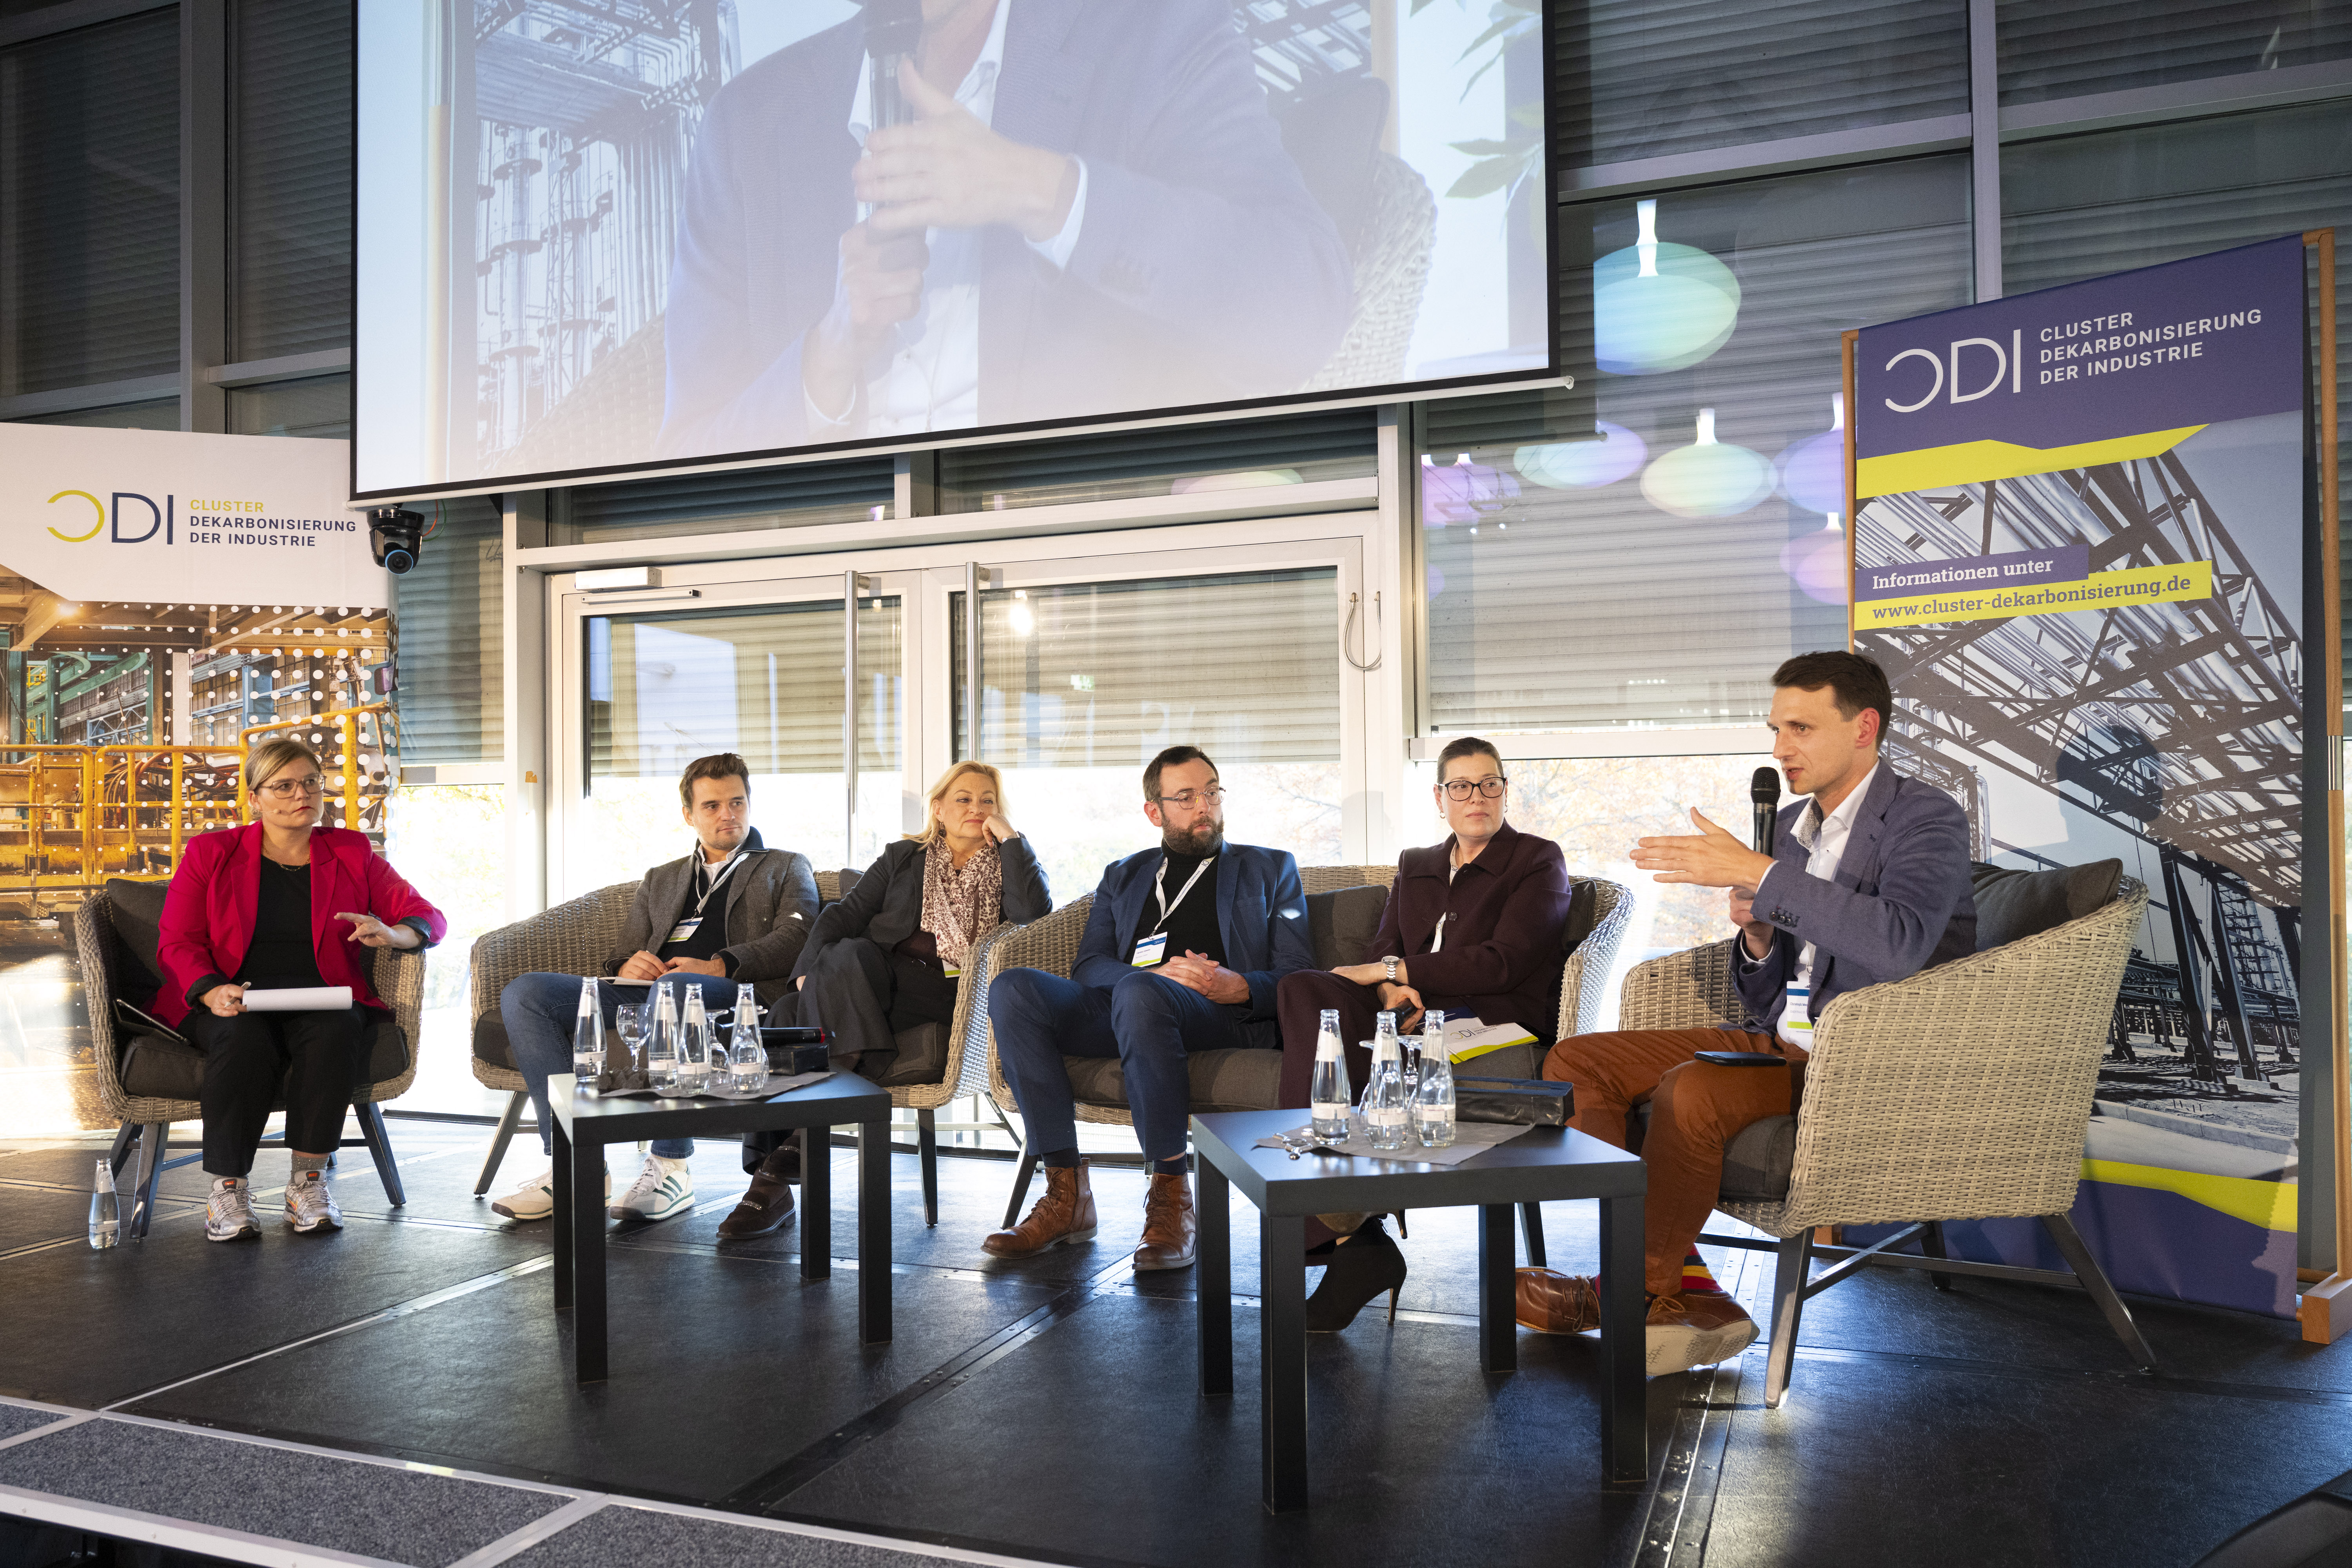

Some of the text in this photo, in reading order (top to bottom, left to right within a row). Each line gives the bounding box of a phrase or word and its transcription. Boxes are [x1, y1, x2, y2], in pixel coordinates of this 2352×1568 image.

[2040, 312, 2132, 342] CLUSTER
[2041, 309, 2261, 363] DEKARBONISIERUNG
[2041, 342, 2203, 385] DER INDUSTRIE
[190, 499, 264, 512] CLUSTER
[190, 516, 356, 532] DEKARBONISIERUNG
[190, 532, 316, 546] DER INDUSTRIE
[1872, 560, 2054, 590] Informationen unter
[1872, 575, 2191, 619] www.cluster-dekarbonisierung.de
